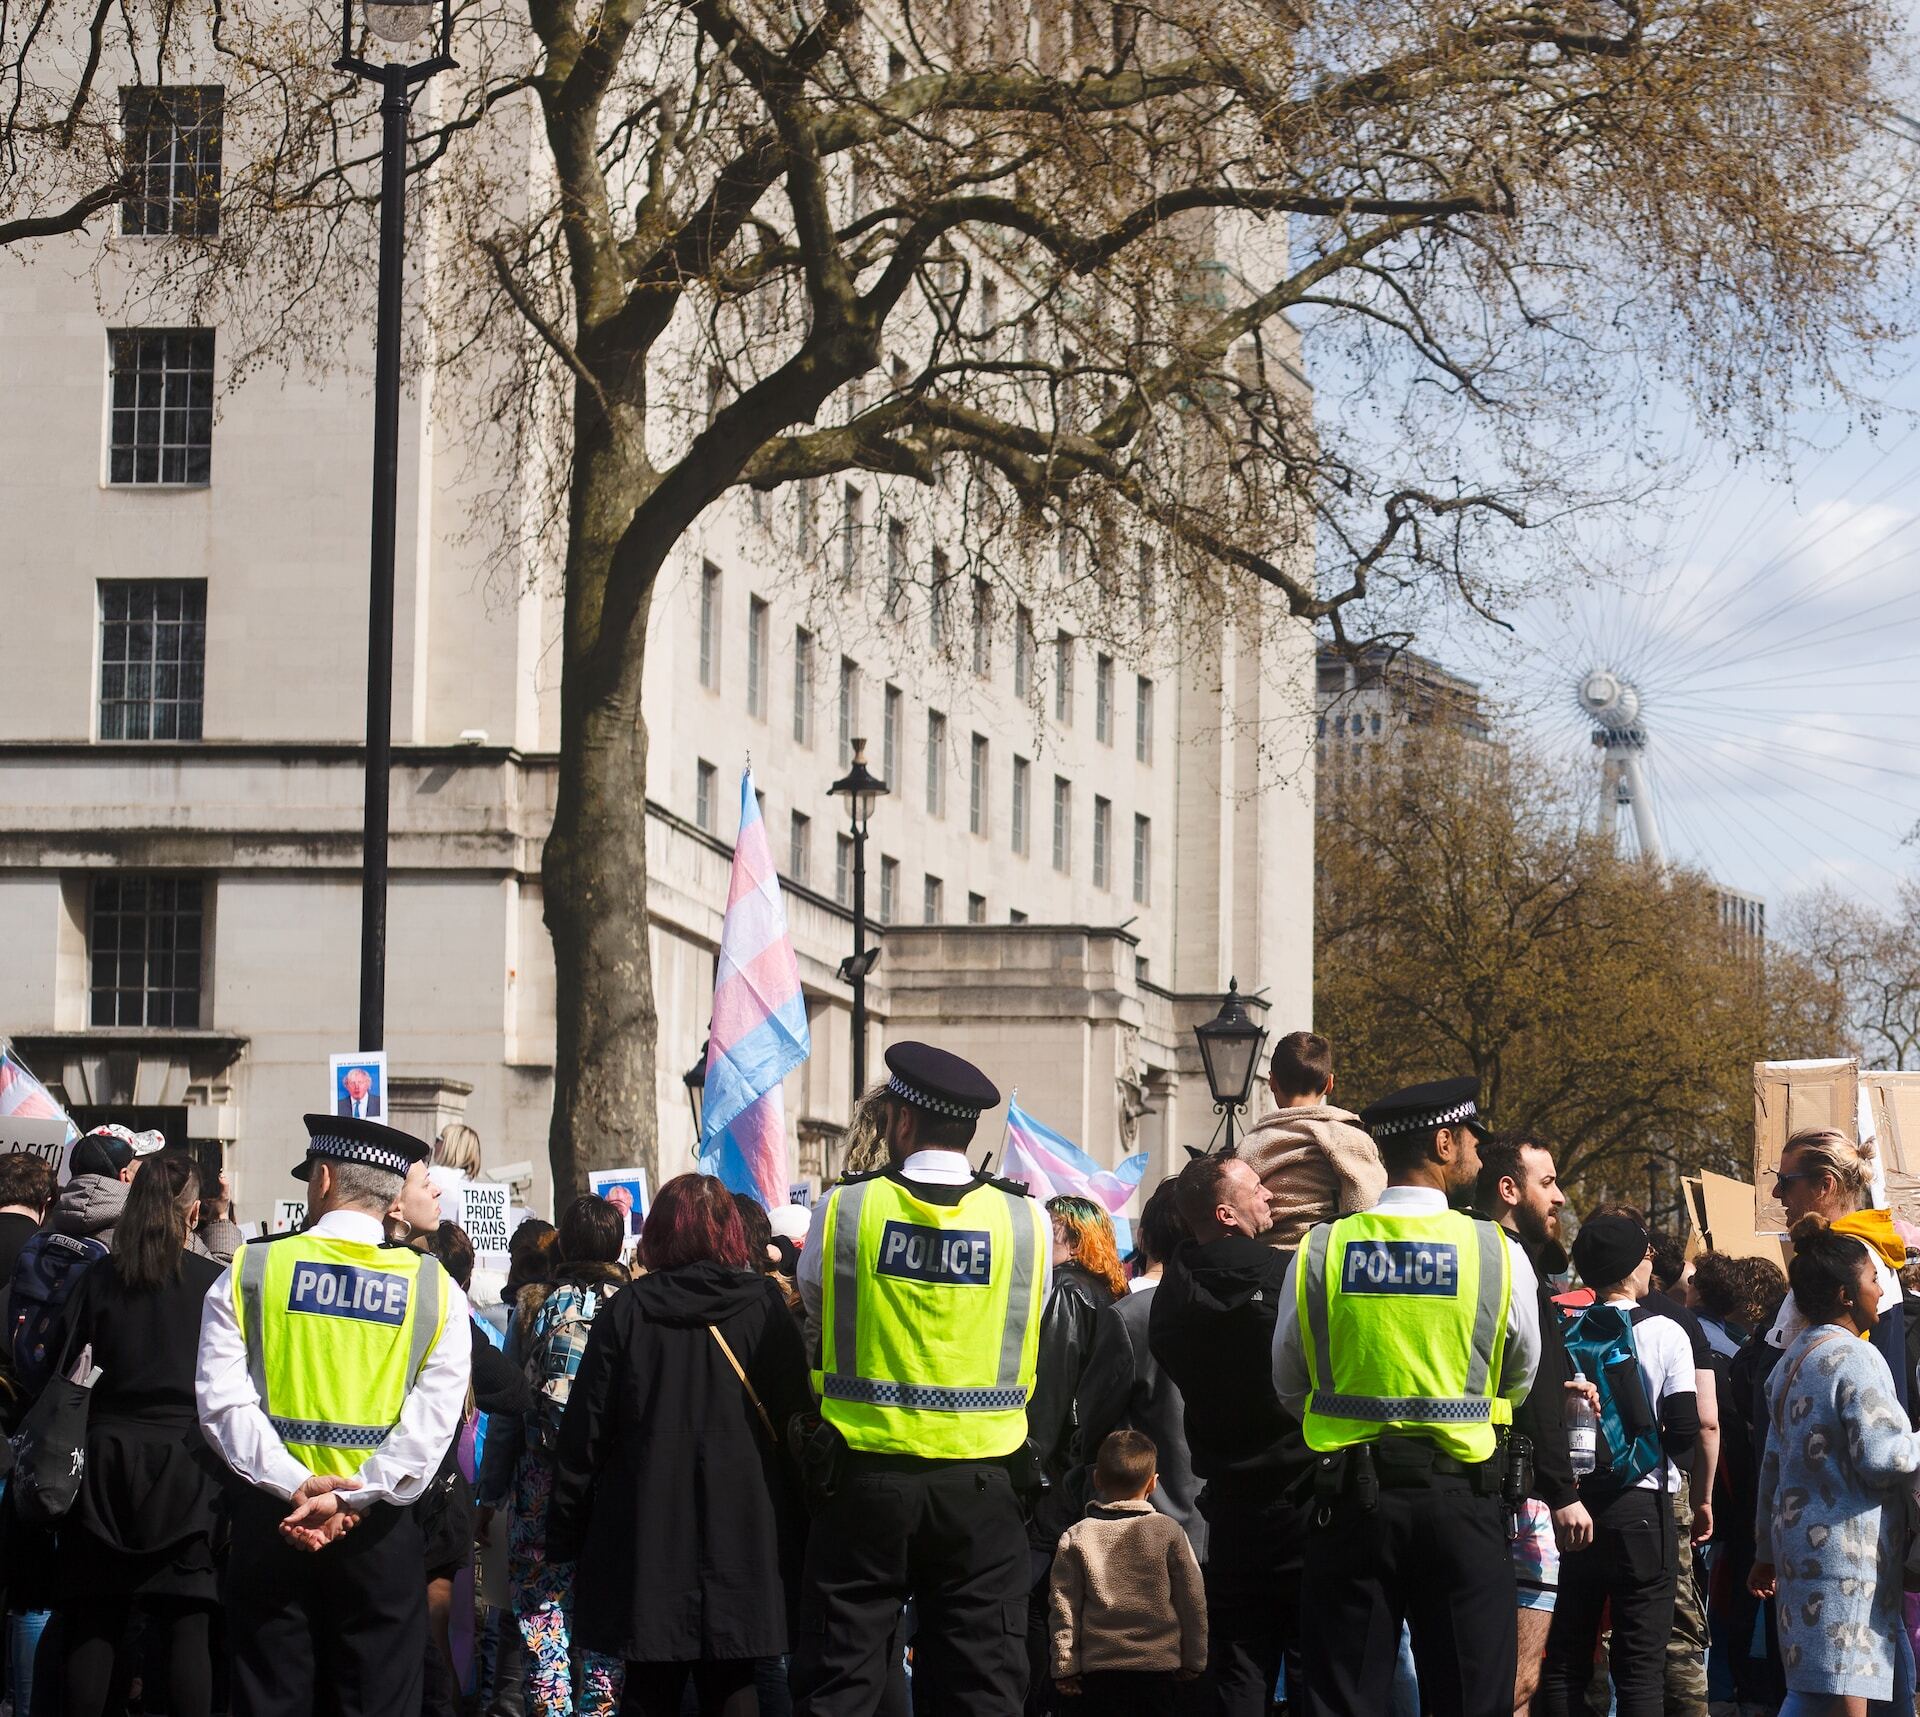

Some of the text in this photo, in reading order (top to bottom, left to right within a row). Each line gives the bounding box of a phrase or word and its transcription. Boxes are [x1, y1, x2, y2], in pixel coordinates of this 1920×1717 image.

[463, 1190, 505, 1204] TRANS
[466, 1205, 503, 1219] PRIDE
[464, 1221, 506, 1235] TRANS
[885, 1231, 986, 1275] POLICE
[1348, 1250, 1452, 1286] POLICE
[295, 1270, 403, 1316] POLICE
